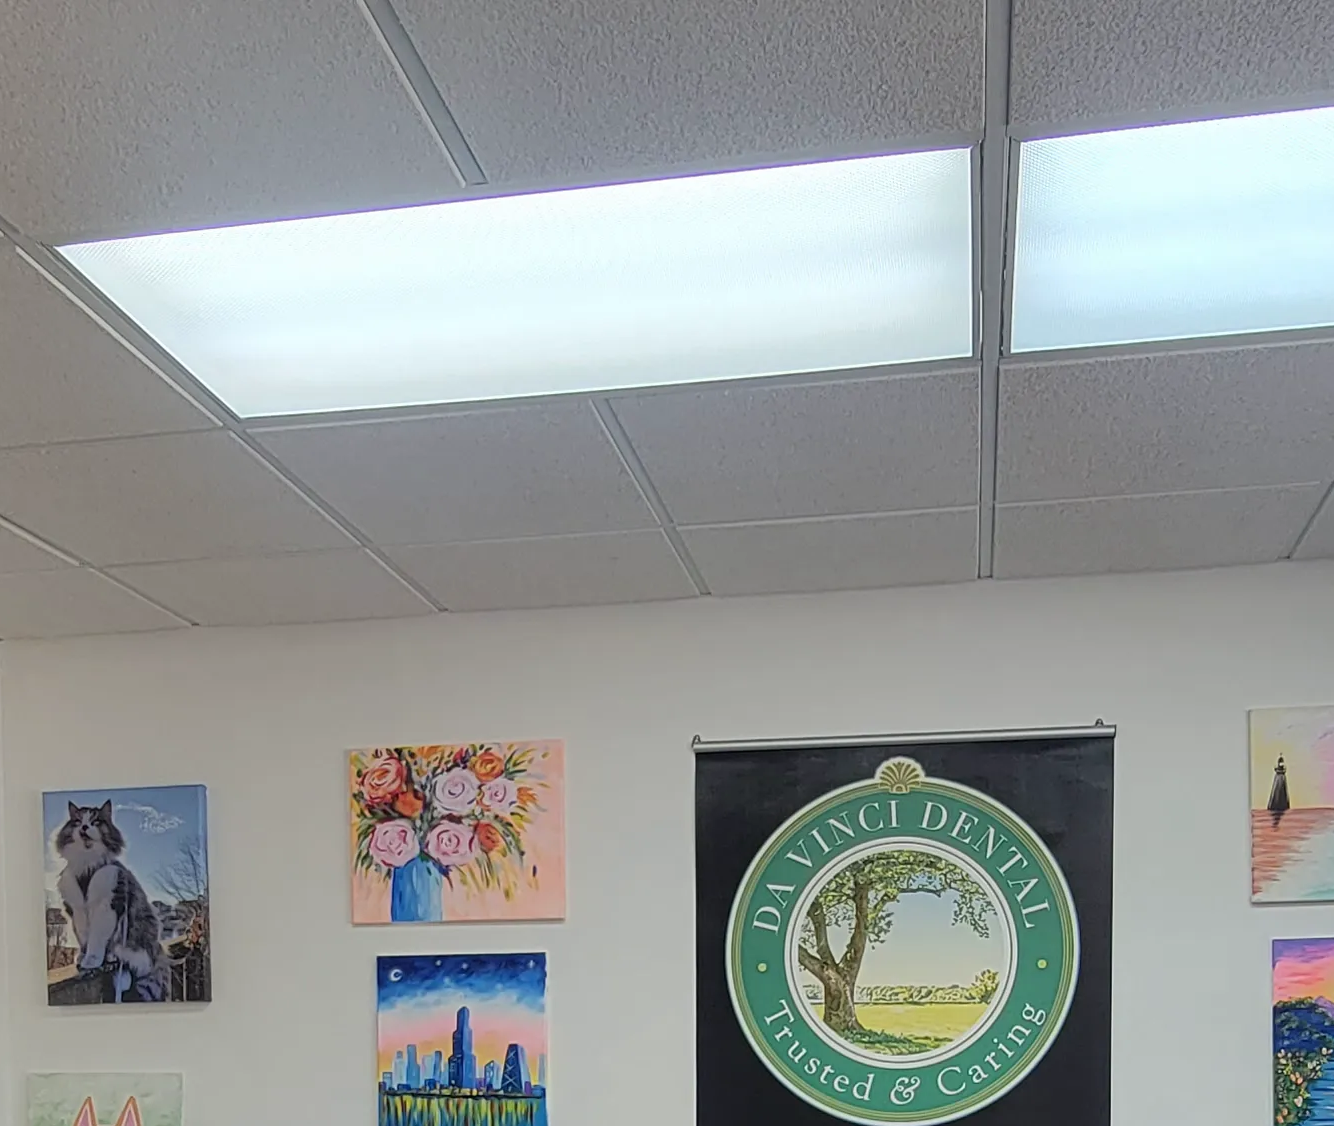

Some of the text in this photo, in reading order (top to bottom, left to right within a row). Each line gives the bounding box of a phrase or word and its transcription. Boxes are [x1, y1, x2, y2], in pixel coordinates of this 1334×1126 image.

[752, 800, 1052, 934] DA VINCI DENTAL
[763, 999, 1047, 1105] Trusted & Caring
